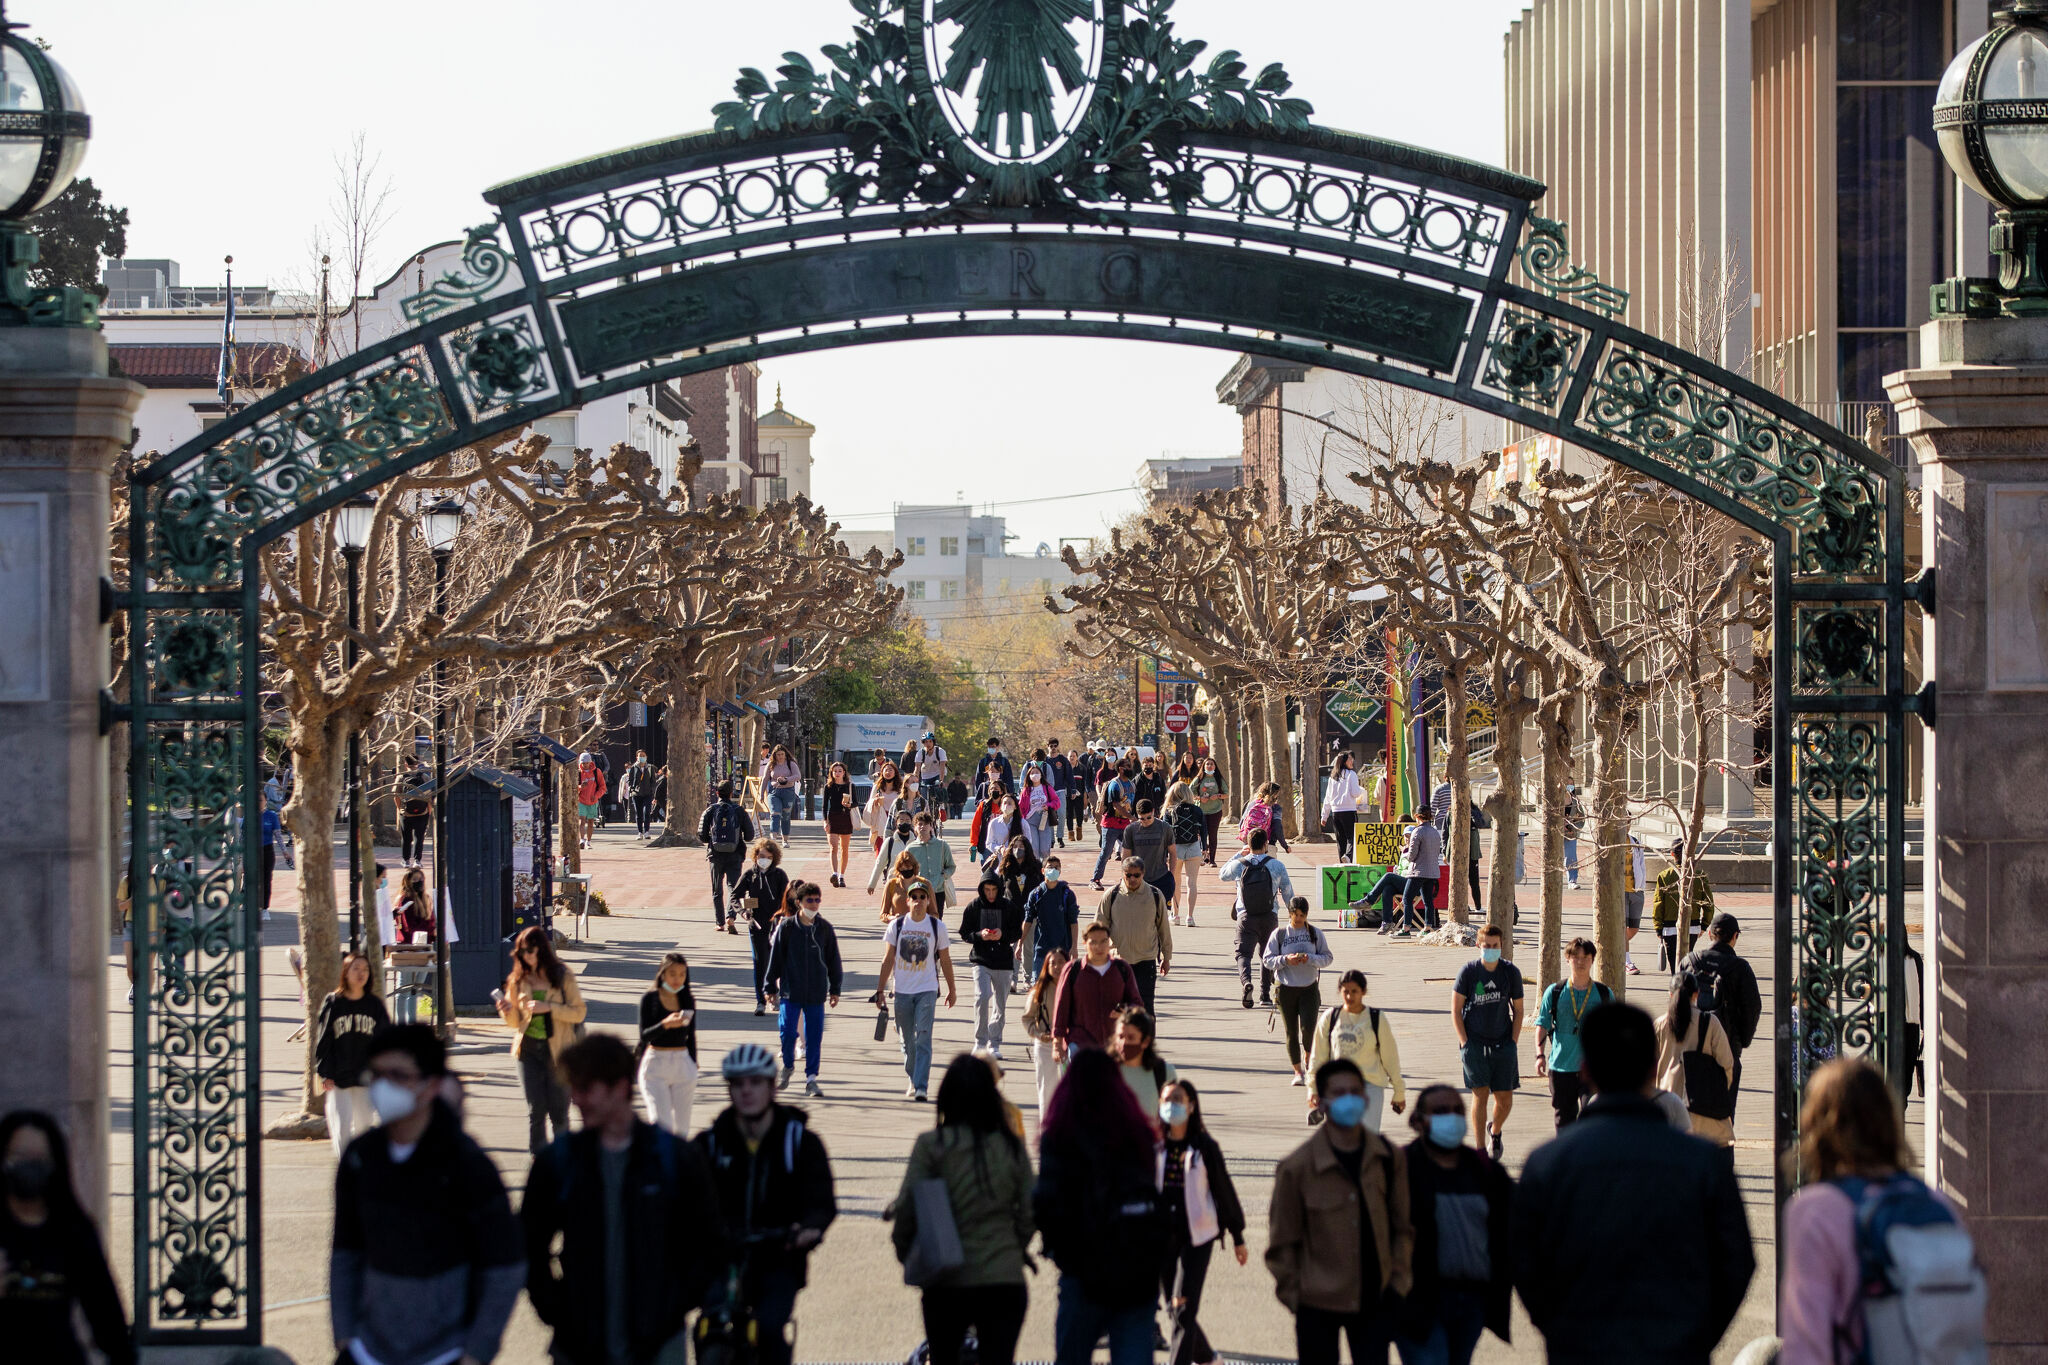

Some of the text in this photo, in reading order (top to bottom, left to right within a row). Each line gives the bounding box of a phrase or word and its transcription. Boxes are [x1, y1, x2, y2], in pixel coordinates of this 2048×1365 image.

[732, 246, 1305, 322] SATHER GATE
[1331, 702, 1374, 711] SUBWAY
[1365, 823, 1407, 836] SHOUL
[1357, 835, 1405, 847] ABORTIO
[1325, 869, 1381, 904] YES
[1283, 934, 1311, 947] BERKELE
[333, 1013, 377, 1039] NEW YOR
